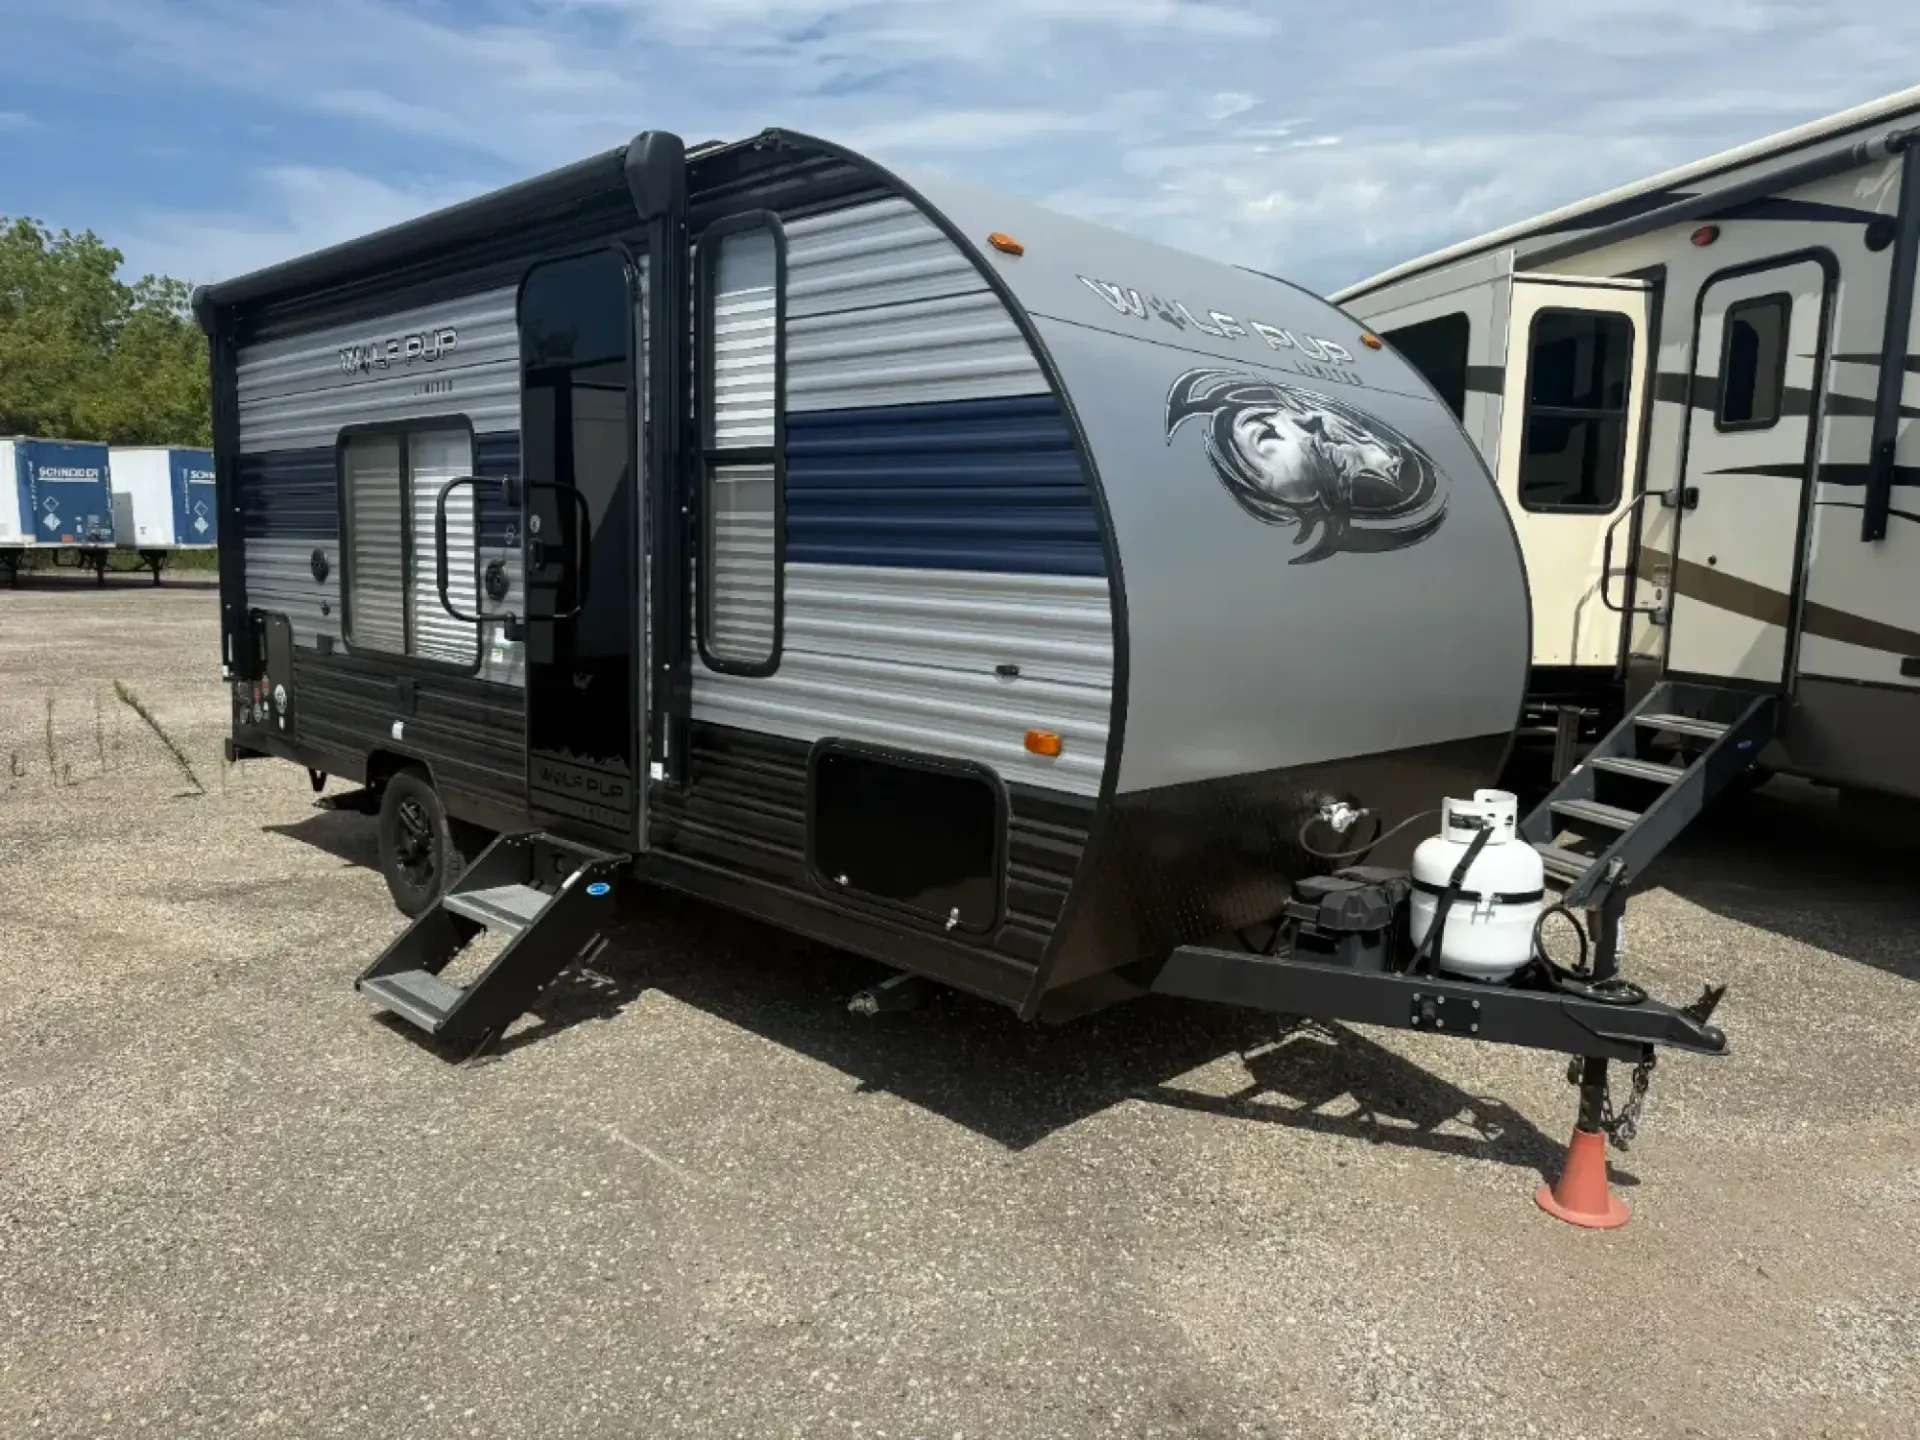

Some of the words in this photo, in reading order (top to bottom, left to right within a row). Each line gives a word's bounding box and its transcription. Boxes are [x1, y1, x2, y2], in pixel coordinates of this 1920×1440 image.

[405, 326, 458, 366] PUP
[1249, 318, 1354, 366] PUP
[38, 466, 99, 478] SCHNEIDER
